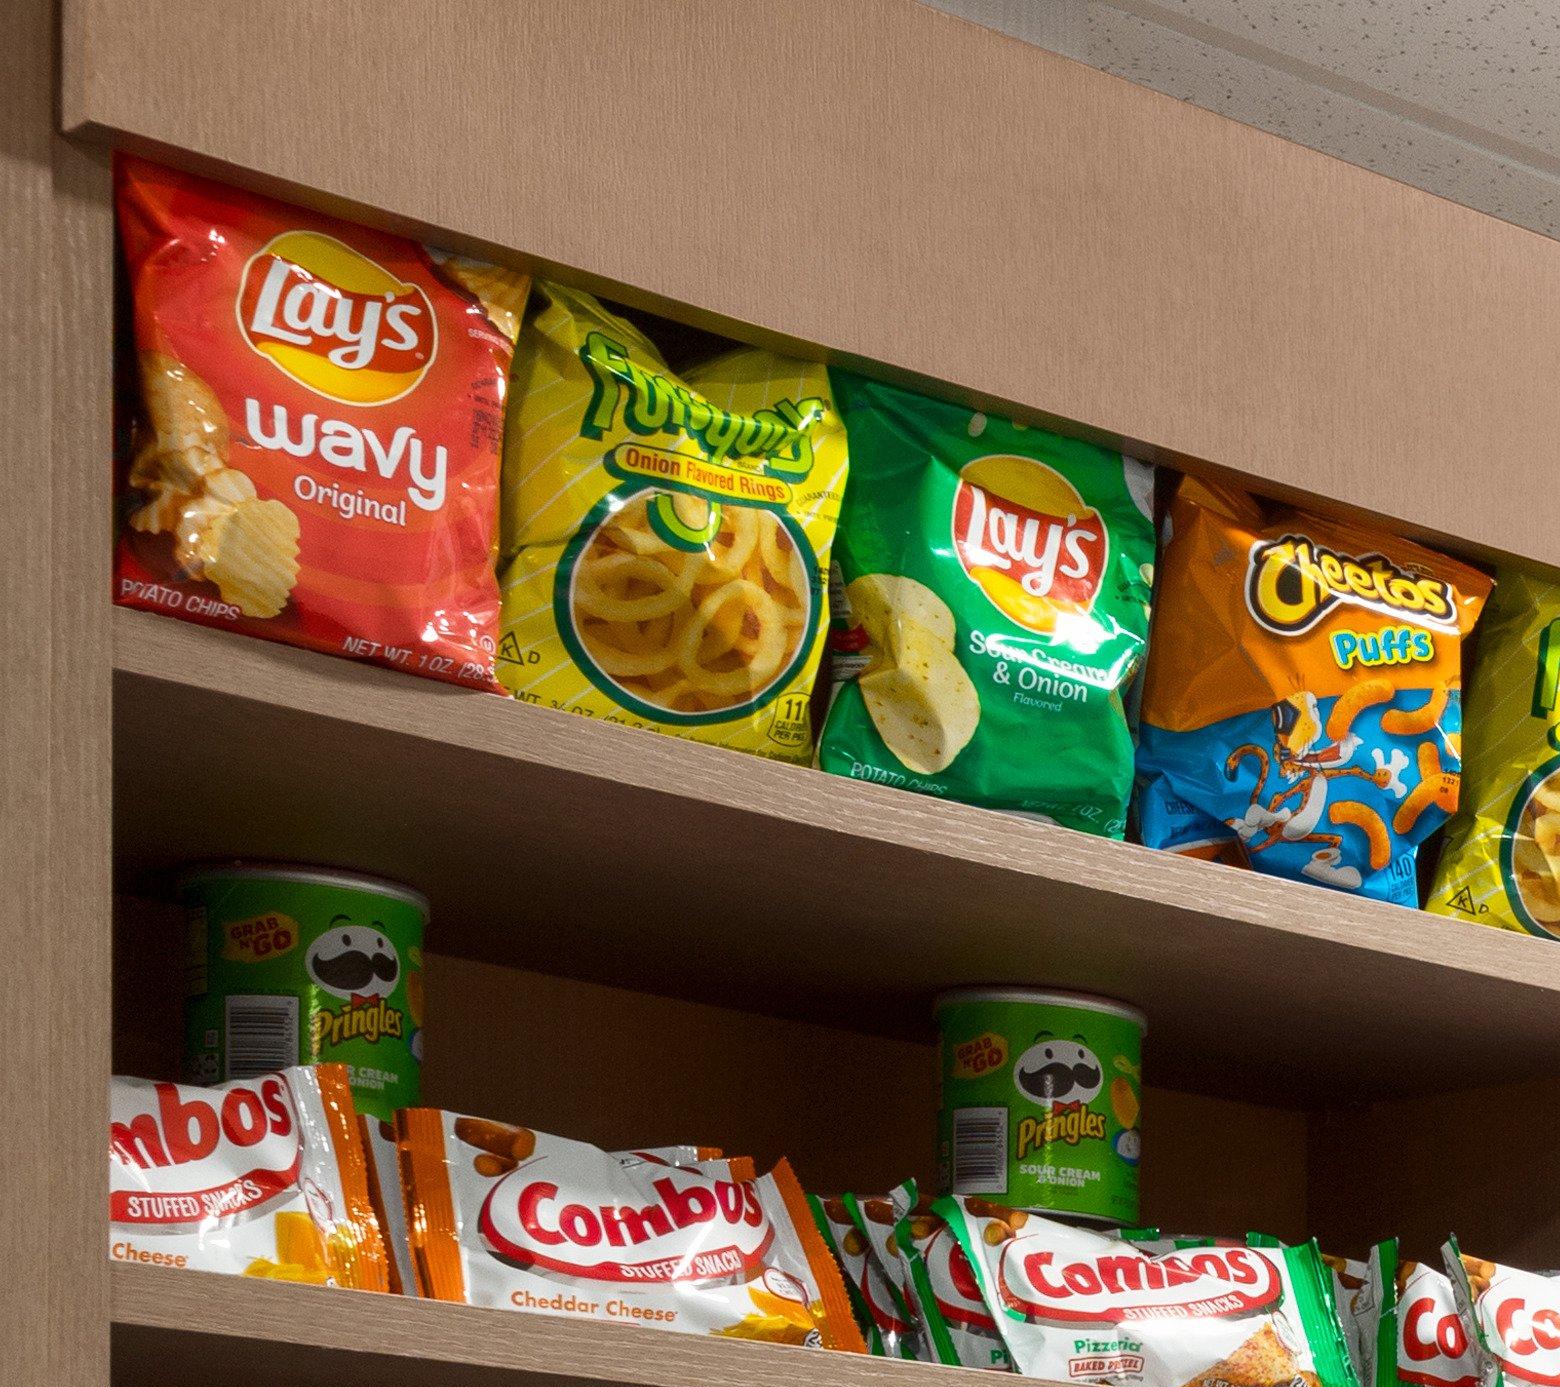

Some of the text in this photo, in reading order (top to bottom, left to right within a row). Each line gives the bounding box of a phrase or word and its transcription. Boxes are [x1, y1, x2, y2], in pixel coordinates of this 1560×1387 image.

[251, 257, 423, 370] Lay's
[245, 398, 448, 512] wavy
[624, 447, 785, 502] Onion Flavored Rings
[294, 474, 406, 527] Original
[966, 486, 1097, 597] Lay's
[1256, 535, 1452, 632] Cheetos
[185, 597, 240, 621] CHIPS
[343, 636, 380, 656] NET
[1335, 628, 1433, 668] Puffs
[993, 660, 1088, 703] & Onion
[1013, 692, 1063, 713] Flavored
[231, 916, 279, 940] GRAB
[253, 930, 292, 956] GO
[311, 1000, 403, 1057] Pringles
[1018, 1105, 1105, 1160] Pringles
[1019, 1164, 1101, 1181] SOUR CREAM
[128, 1194, 198, 1220] STUFFED
[518, 1177, 764, 1249] Combos
[113, 1242, 188, 1268] Cheese
[511, 1290, 677, 1323] Cheddar Cheese
[1124, 1295, 1244, 1321] STUFFED SNACKS
[1074, 1338, 1142, 1354] Pizzeria
[1074, 1362, 1105, 1373] BAKED
